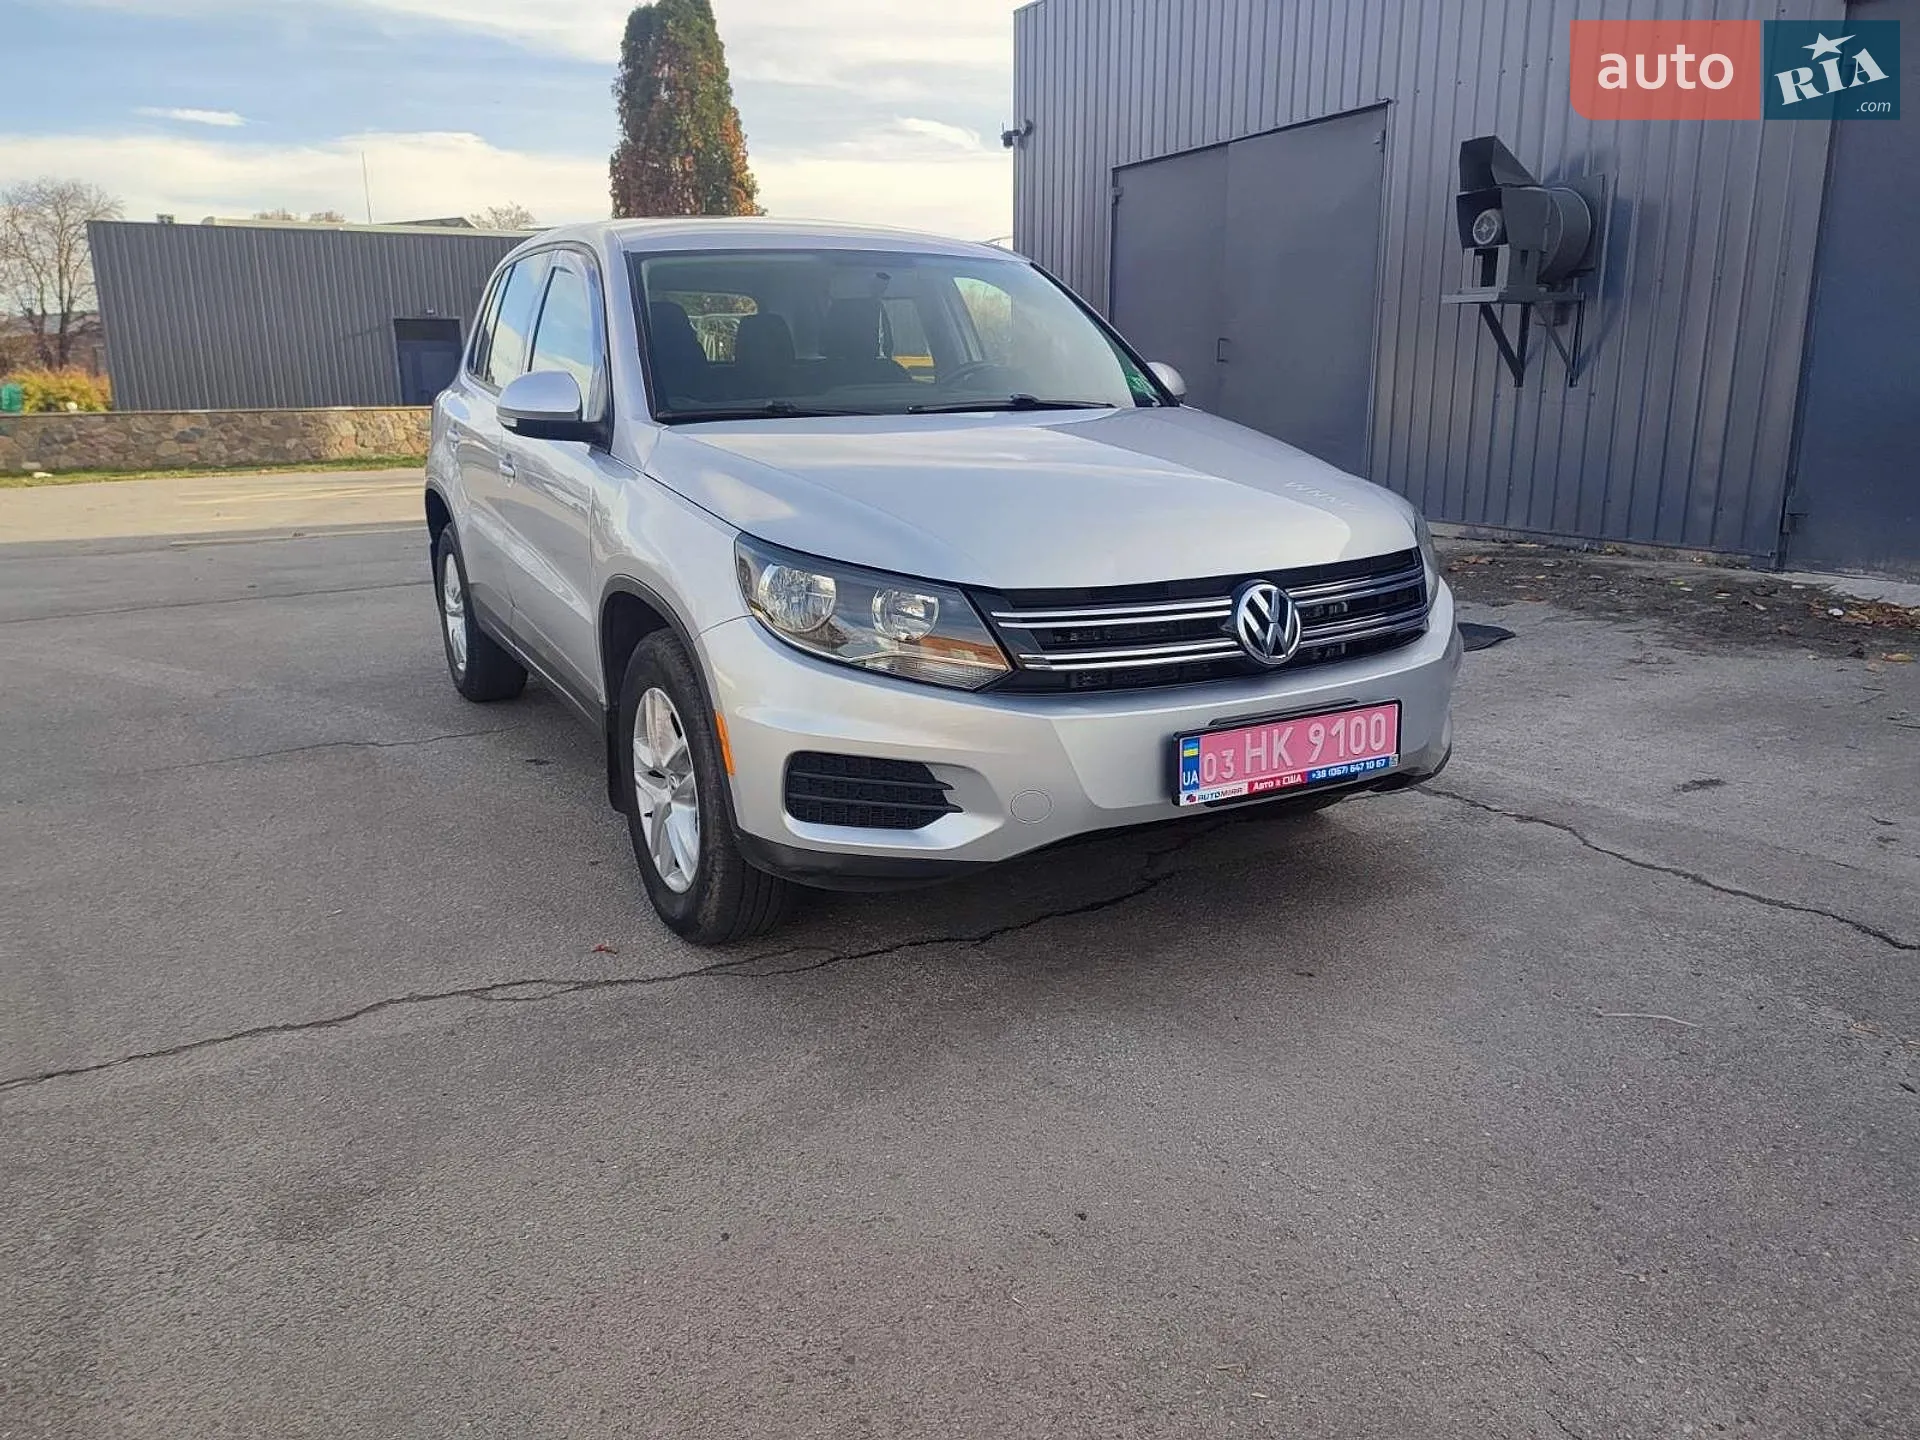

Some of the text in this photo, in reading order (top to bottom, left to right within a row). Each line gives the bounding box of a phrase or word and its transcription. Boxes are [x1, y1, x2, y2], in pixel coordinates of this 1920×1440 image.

[1203, 713, 1387, 783] 03 HK 9100
[1183, 771, 1199, 786] UA
